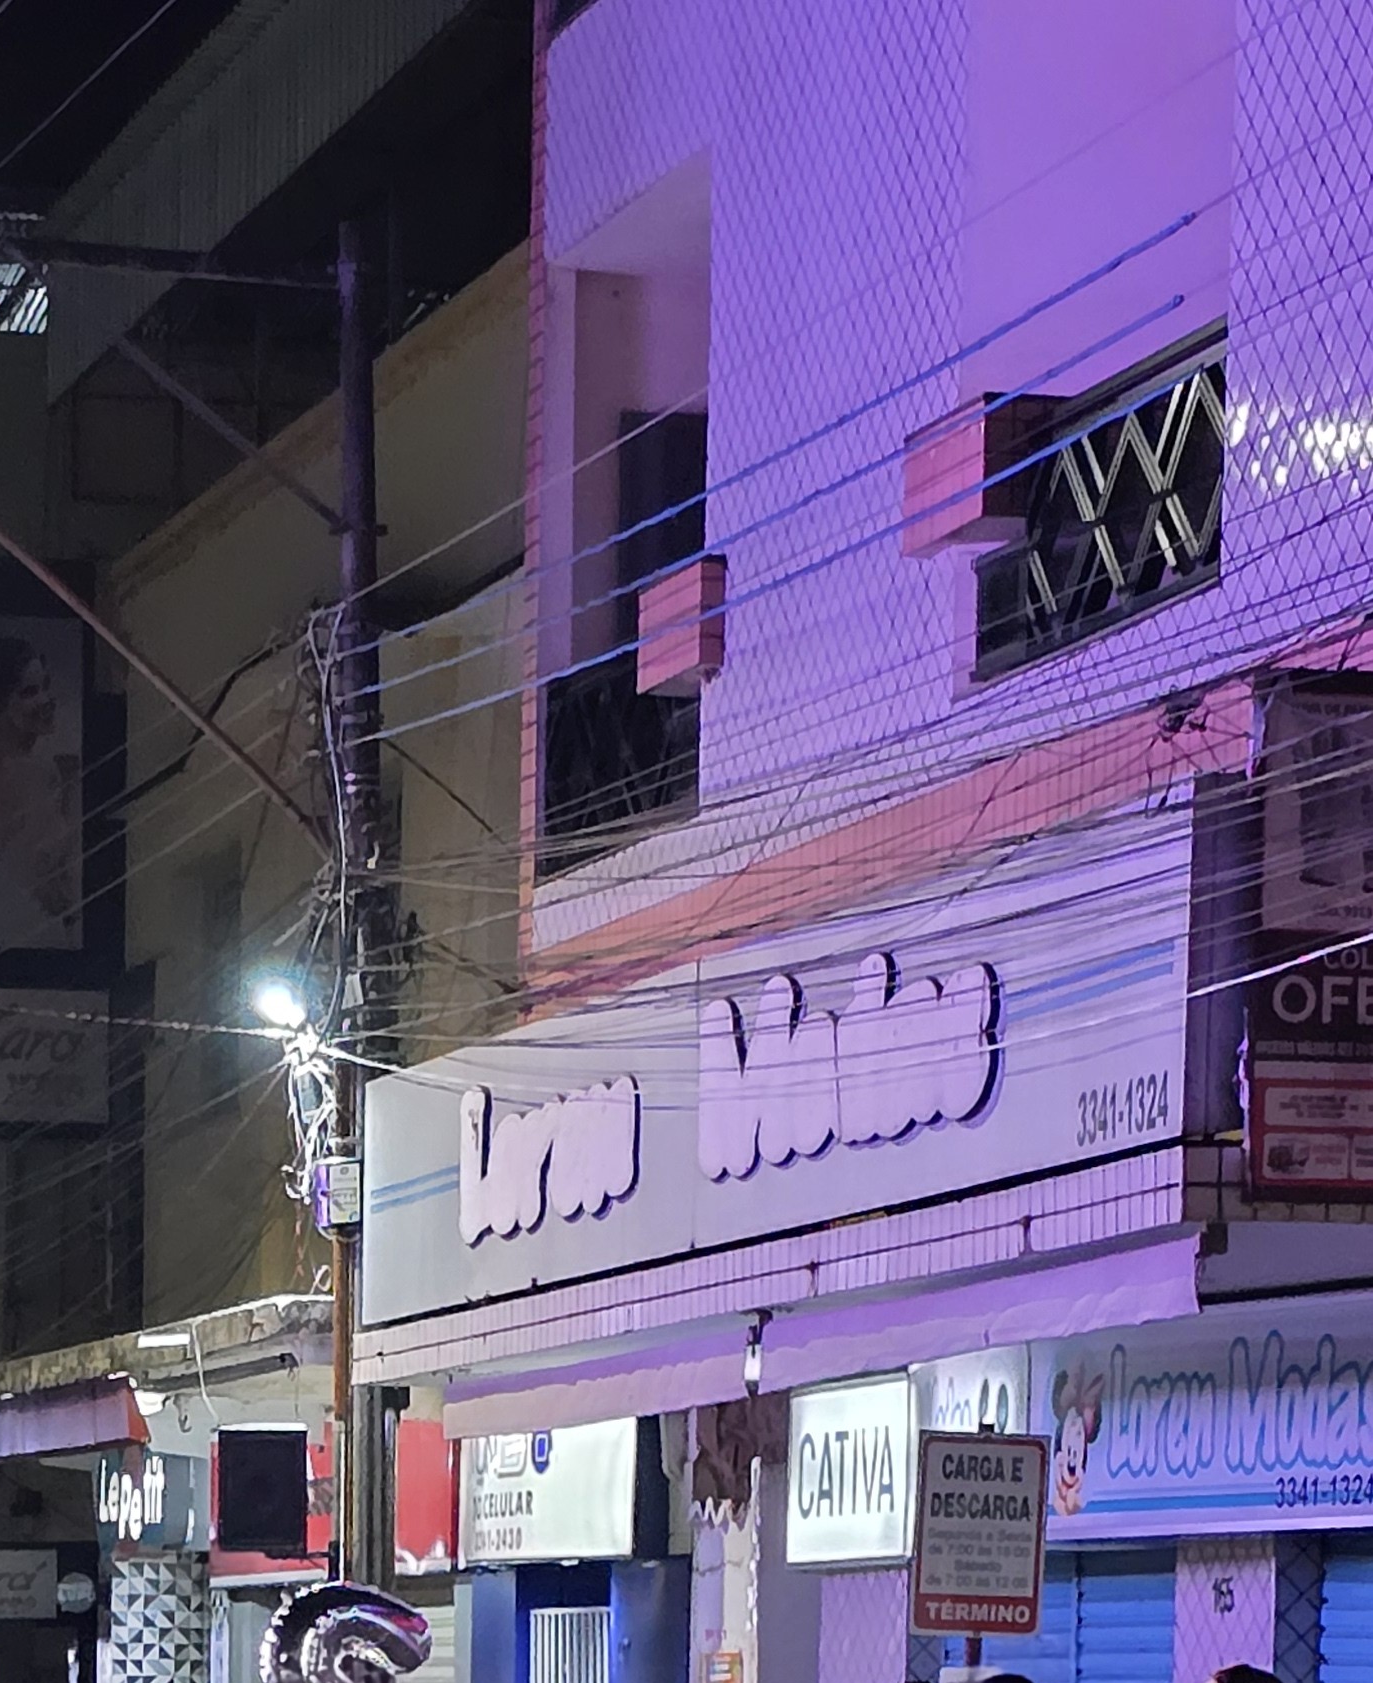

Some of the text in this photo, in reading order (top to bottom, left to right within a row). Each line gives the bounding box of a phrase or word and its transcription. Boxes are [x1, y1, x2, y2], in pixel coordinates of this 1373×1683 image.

[1076, 1071, 1170, 1146] 3341-1324
[1106, 1344, 1216, 1479] Loren
[798, 1425, 896, 1520] CATIVA
[942, 1454, 1024, 1482] CARGA E
[483, 1490, 534, 1519] CELULAR
[930, 1492, 1031, 1522] DESCARGA
[1275, 1474, 1373, 1508] 3341-1324
[926, 1599, 1031, 1624] TÉRMINO
[1212, 1577, 1236, 1615] 165
